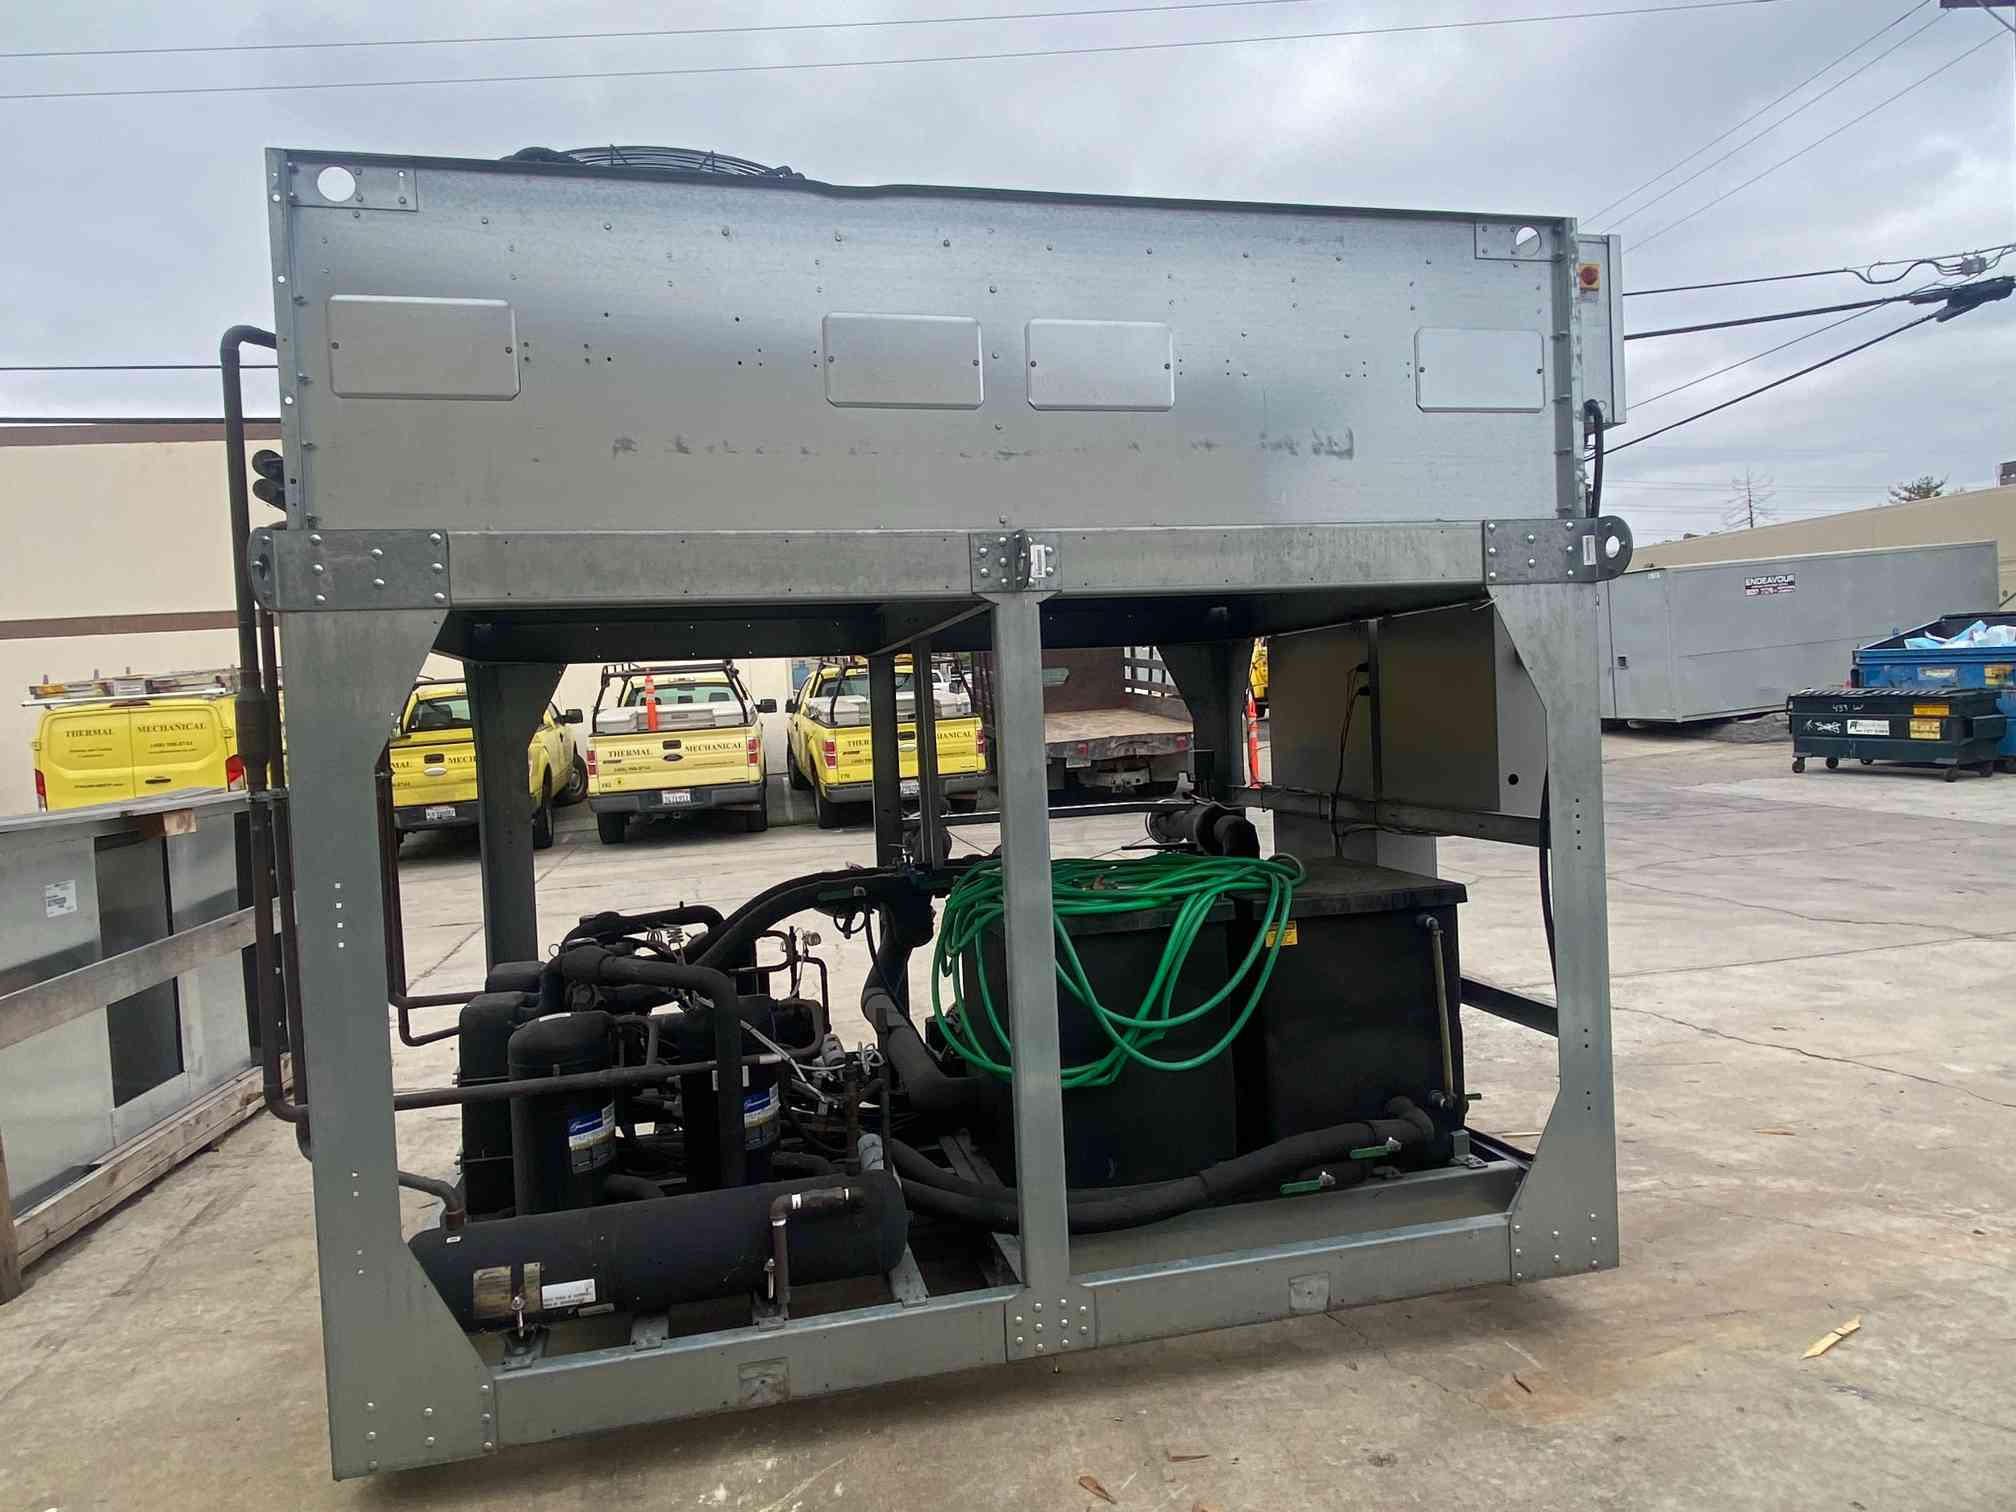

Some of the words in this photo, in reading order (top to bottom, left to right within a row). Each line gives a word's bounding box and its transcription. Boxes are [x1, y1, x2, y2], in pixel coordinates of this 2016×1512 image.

[1745, 575, 1795, 586] ENDEAVOUR
[65, 728, 114, 739] THERMAL
[137, 722, 207, 734] MECHANICAL
[608, 748, 652, 758] THERMAL
[685, 742, 743, 753] MECHANICAL
